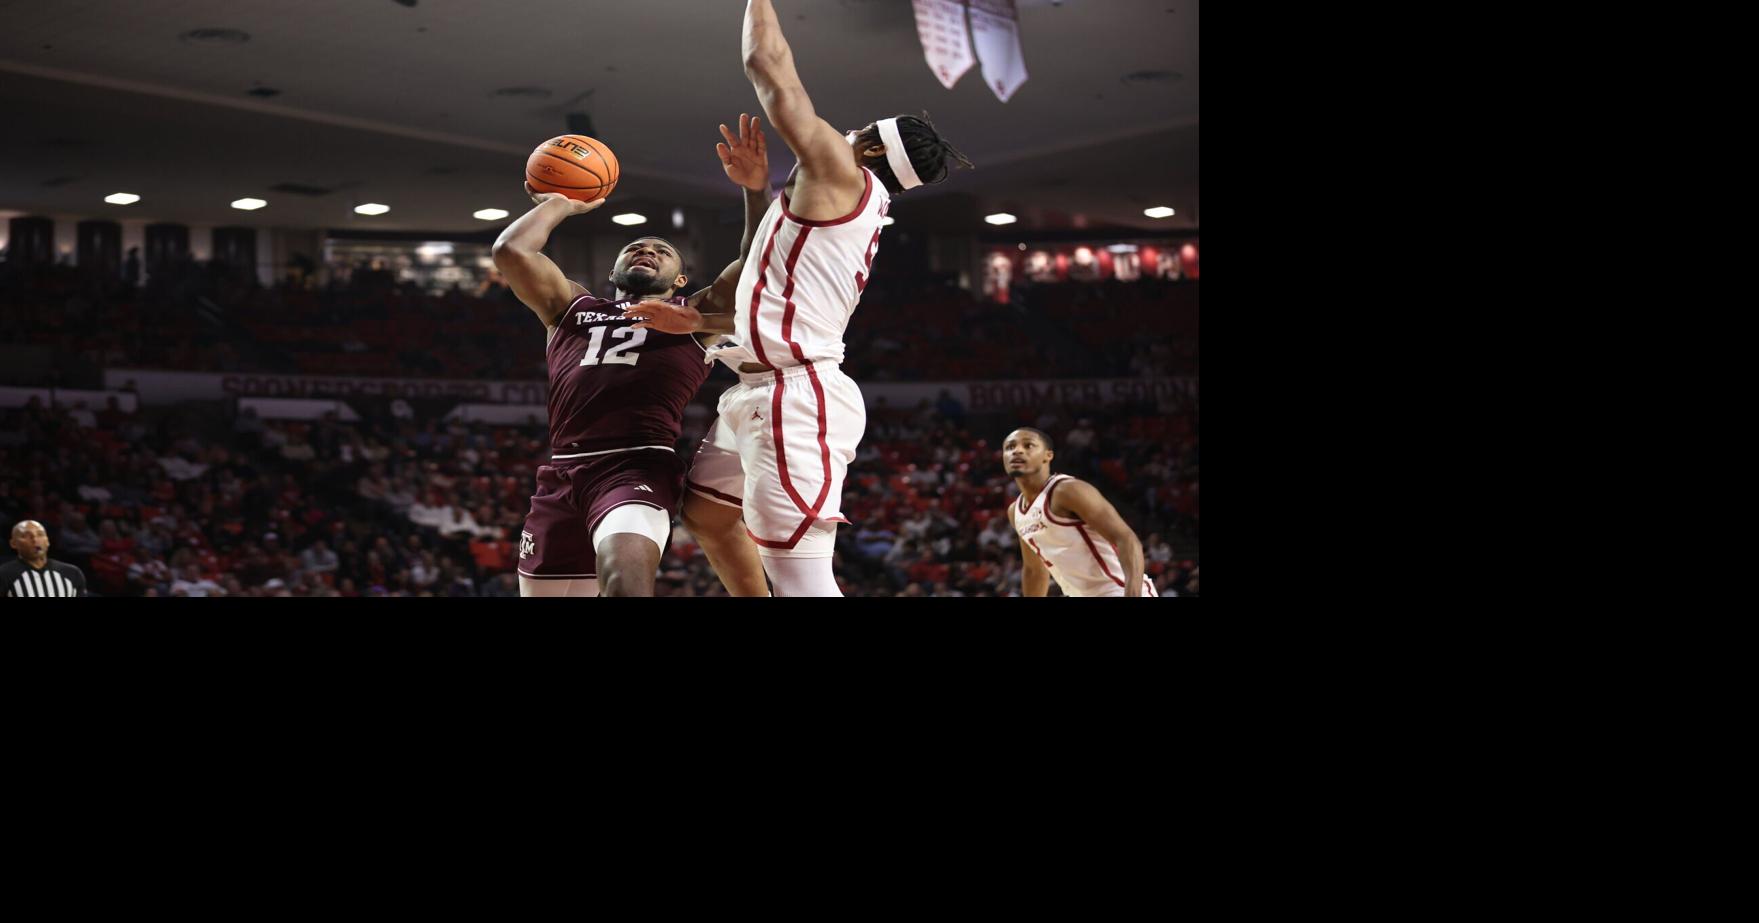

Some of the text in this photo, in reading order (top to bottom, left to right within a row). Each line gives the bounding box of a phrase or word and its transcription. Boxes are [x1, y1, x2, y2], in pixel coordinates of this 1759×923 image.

[580, 325, 648, 366] 12
[968, 380, 1199, 408] BOOMER SOON
